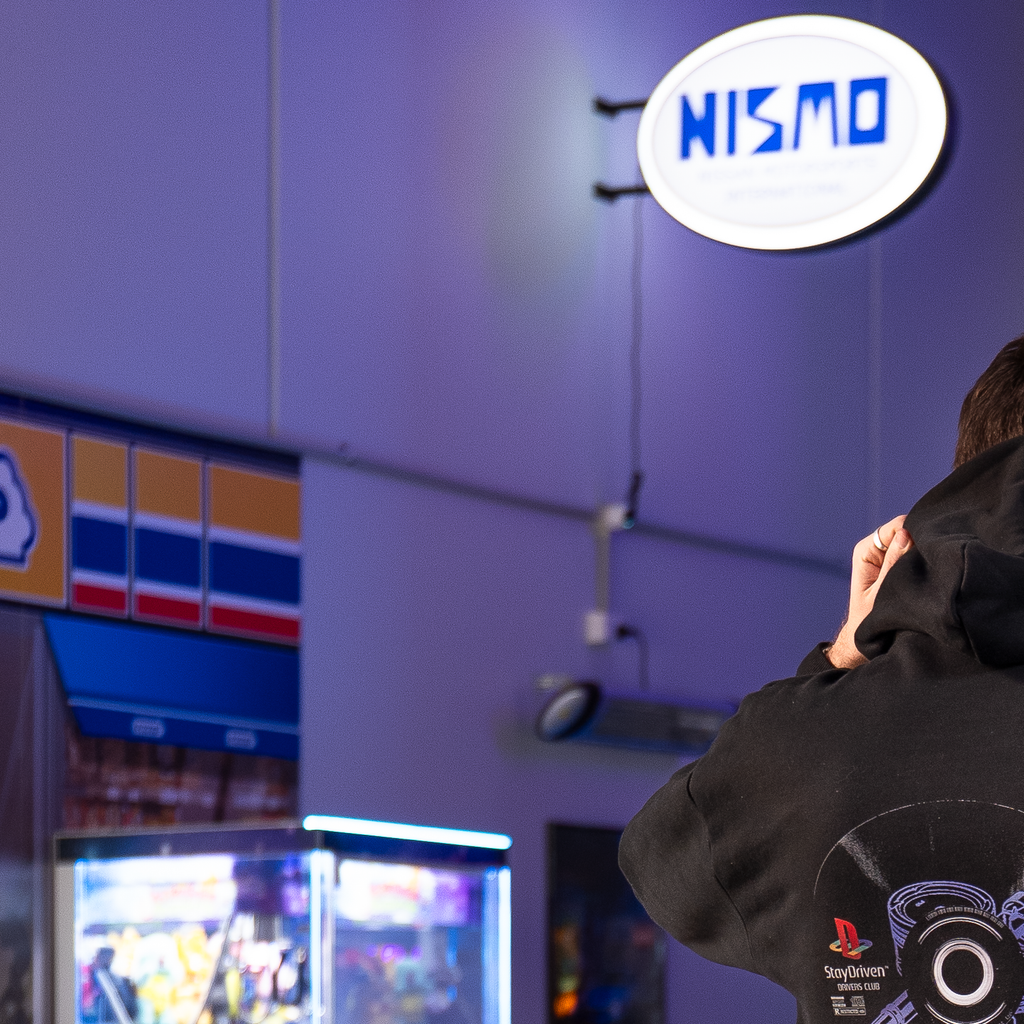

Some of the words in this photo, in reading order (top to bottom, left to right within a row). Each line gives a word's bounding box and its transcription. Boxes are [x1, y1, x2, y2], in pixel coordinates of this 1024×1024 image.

[679, 76, 888, 161] NISMO
[837, 982, 863, 991] DRIVERS
[864, 982, 880, 991] CLUB
